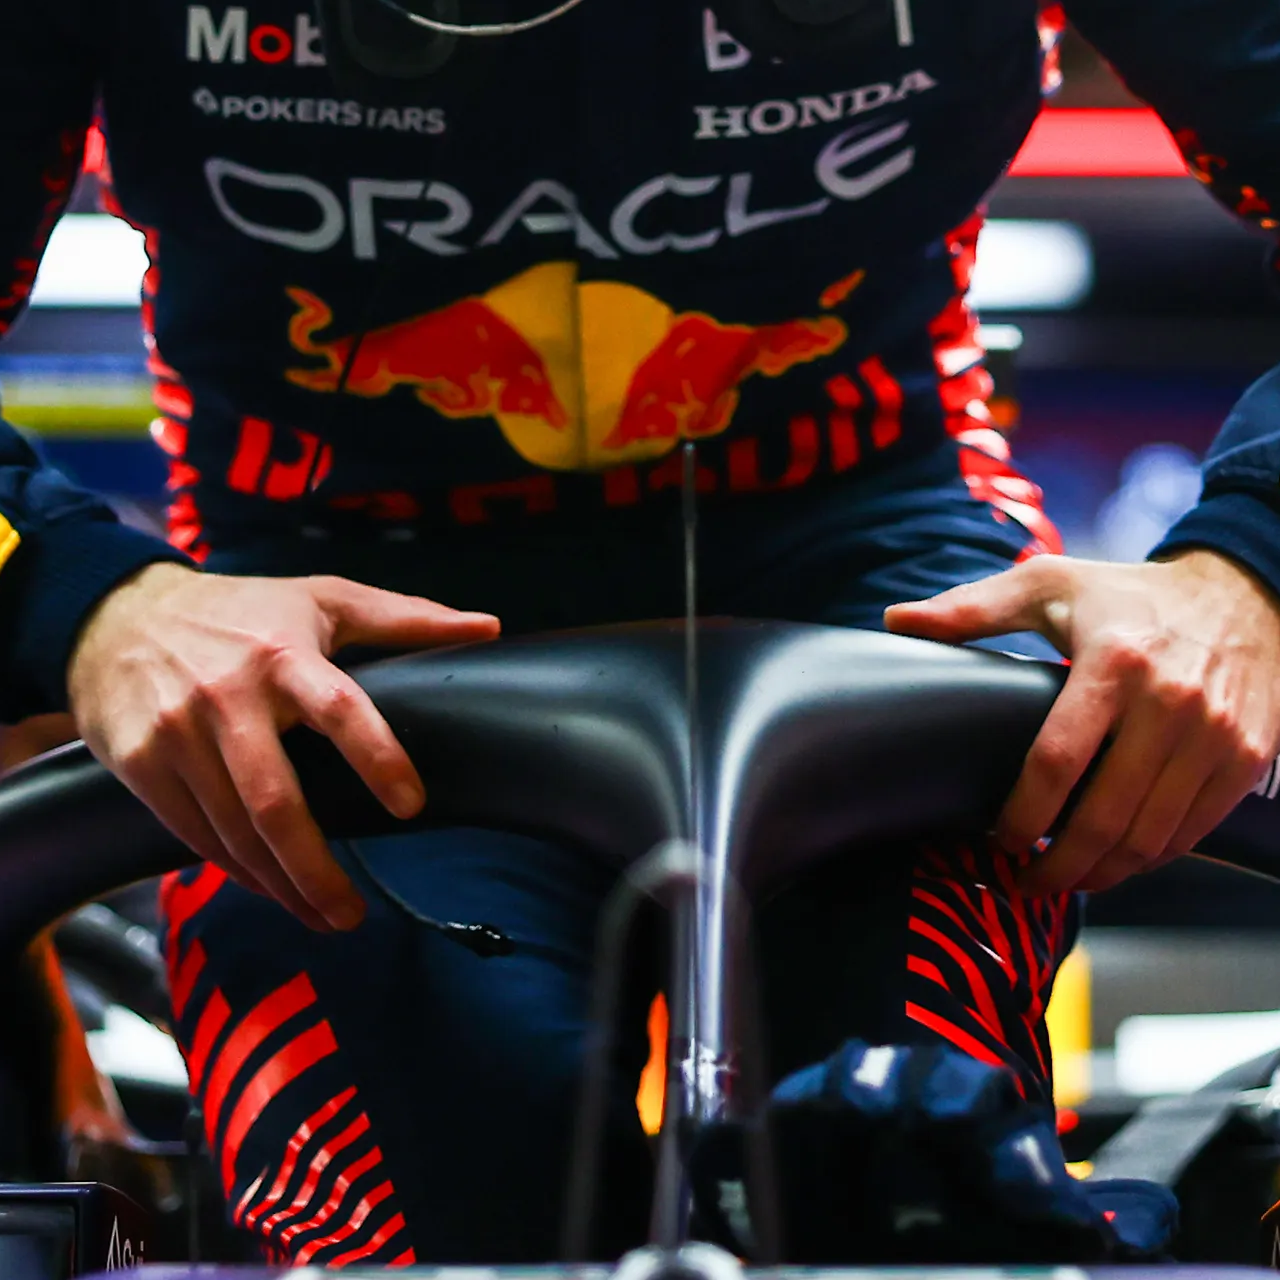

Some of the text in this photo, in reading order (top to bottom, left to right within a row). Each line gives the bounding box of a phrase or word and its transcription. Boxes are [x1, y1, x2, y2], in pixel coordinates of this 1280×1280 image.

[186, 4, 328, 68] Mob
[693, 69, 940, 140] HONDA
[206, 119, 917, 262] ORACLE
